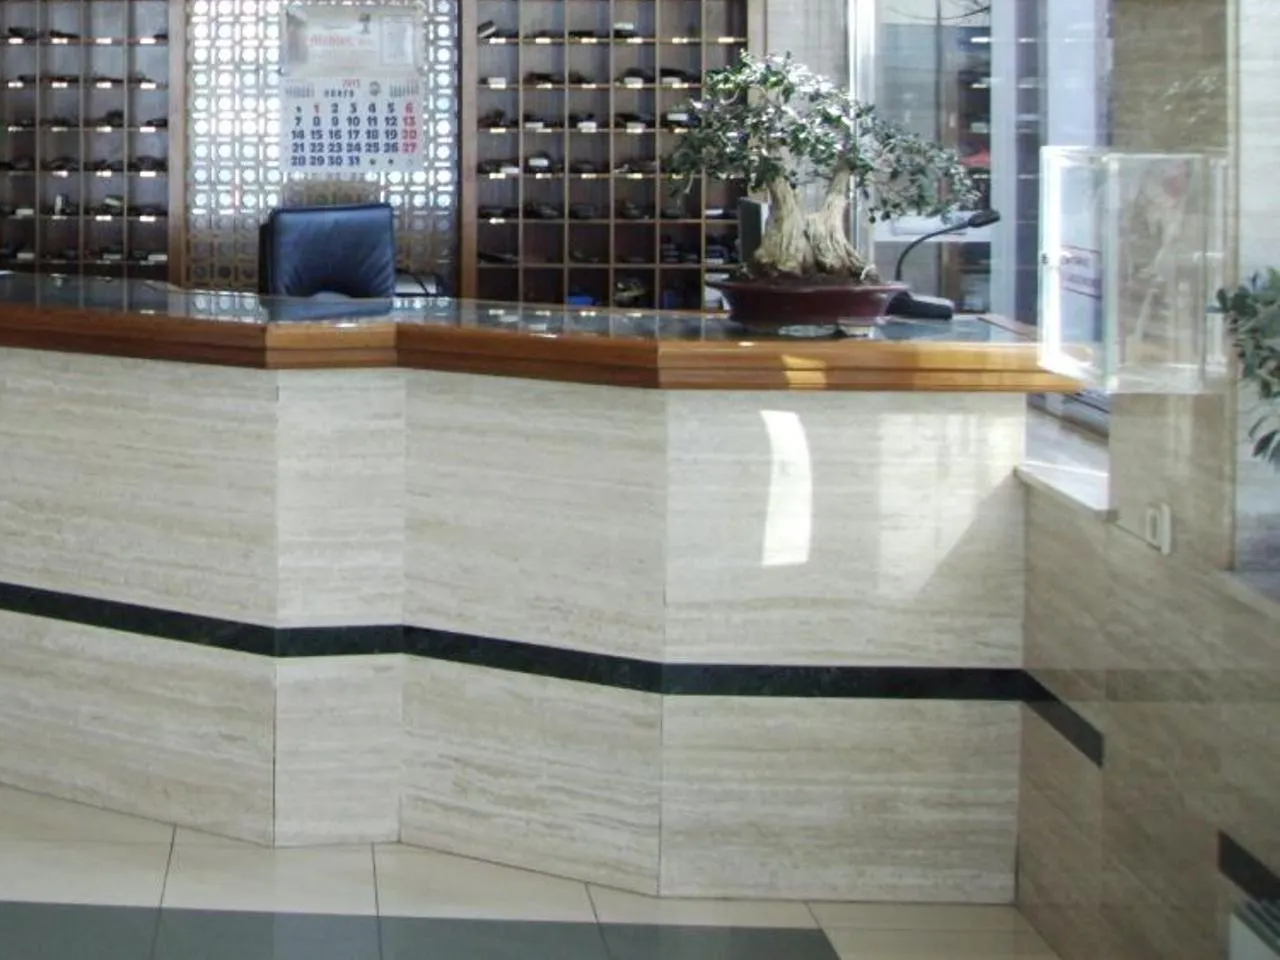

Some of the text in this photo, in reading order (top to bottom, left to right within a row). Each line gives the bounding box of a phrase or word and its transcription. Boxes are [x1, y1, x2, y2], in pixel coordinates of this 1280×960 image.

[313, 103, 413, 114] 1 2 3 4 5 6
[295, 116, 416, 127] 7 8 9 10 11 12 13
[291, 129, 417, 140] 14 15 16 17 18 19 20
[292, 142, 417, 153] 21 22 23 24 25 26 27
[290, 155, 360, 166] 28 29 30 31
